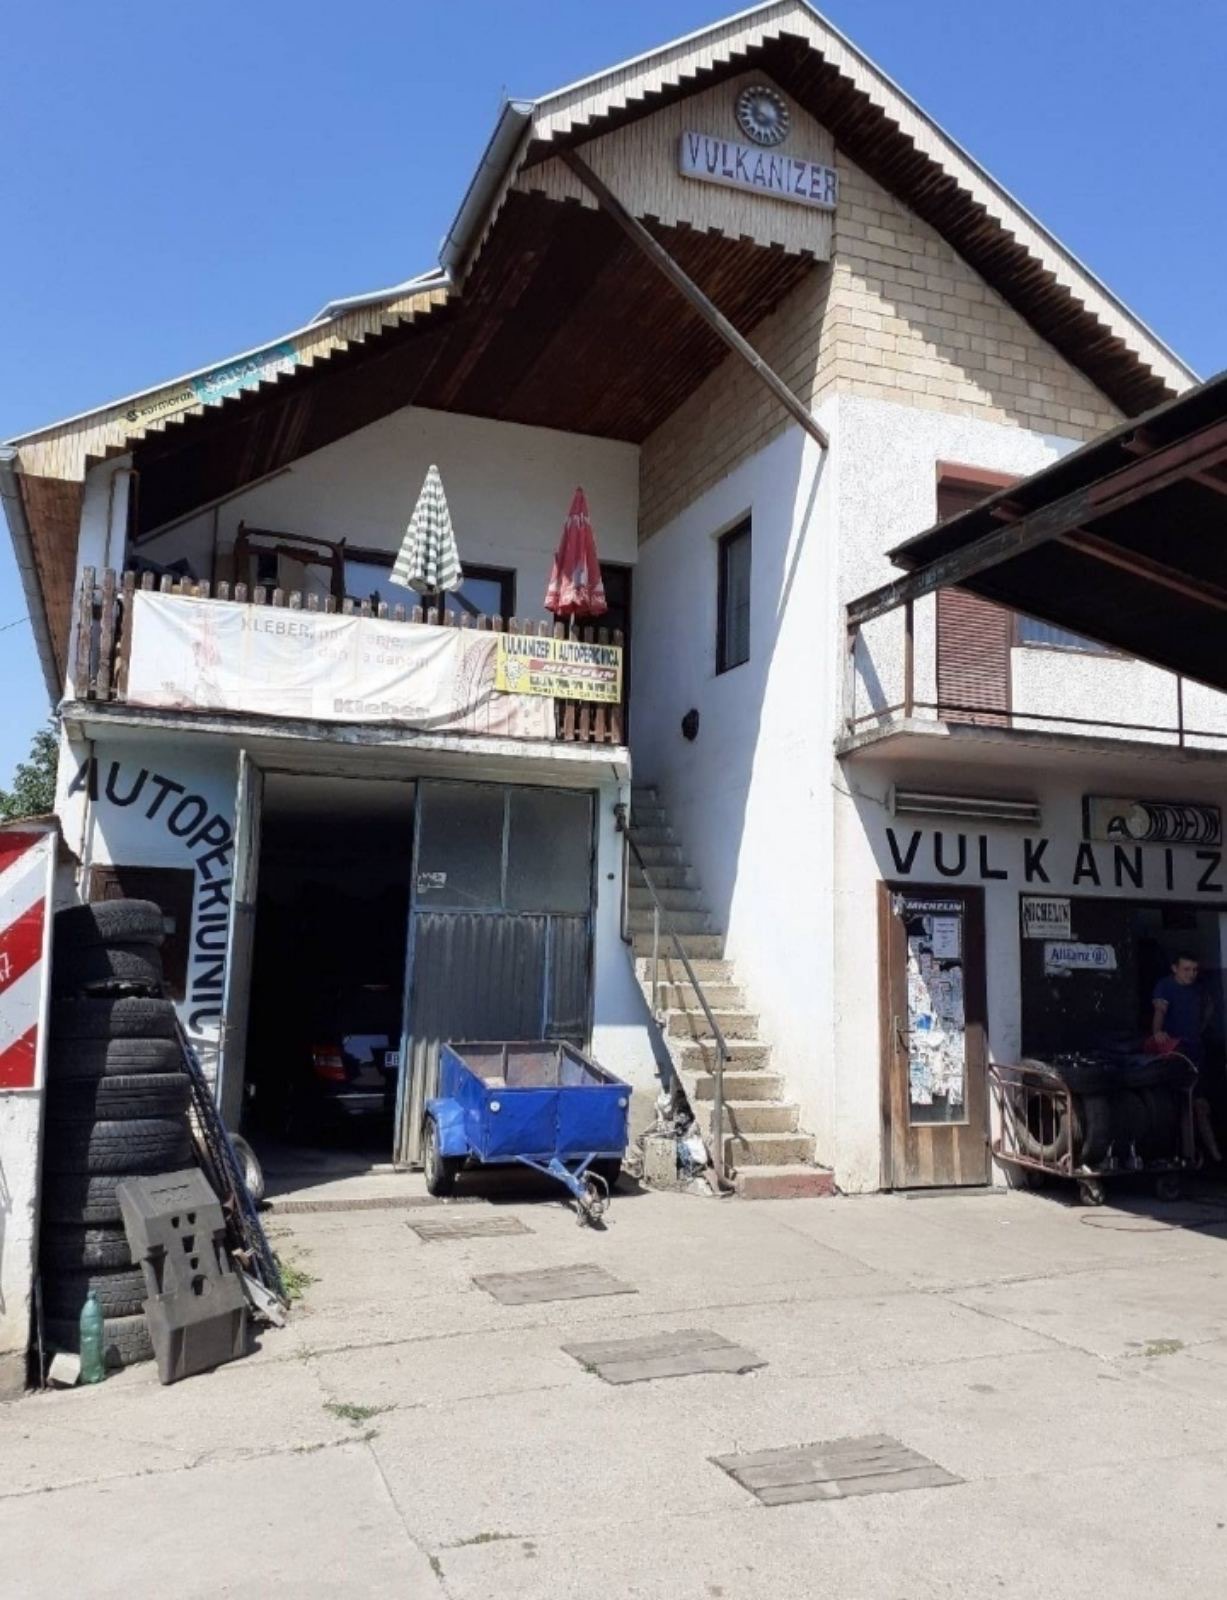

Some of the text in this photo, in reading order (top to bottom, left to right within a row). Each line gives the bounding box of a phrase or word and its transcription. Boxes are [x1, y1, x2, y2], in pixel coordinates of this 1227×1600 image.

[687, 132, 837, 204] VULKANIZER
[333, 698, 430, 719] Kleber
[906, 902, 961, 912] MICHELIN
[1051, 948, 1090, 961] Allianz
